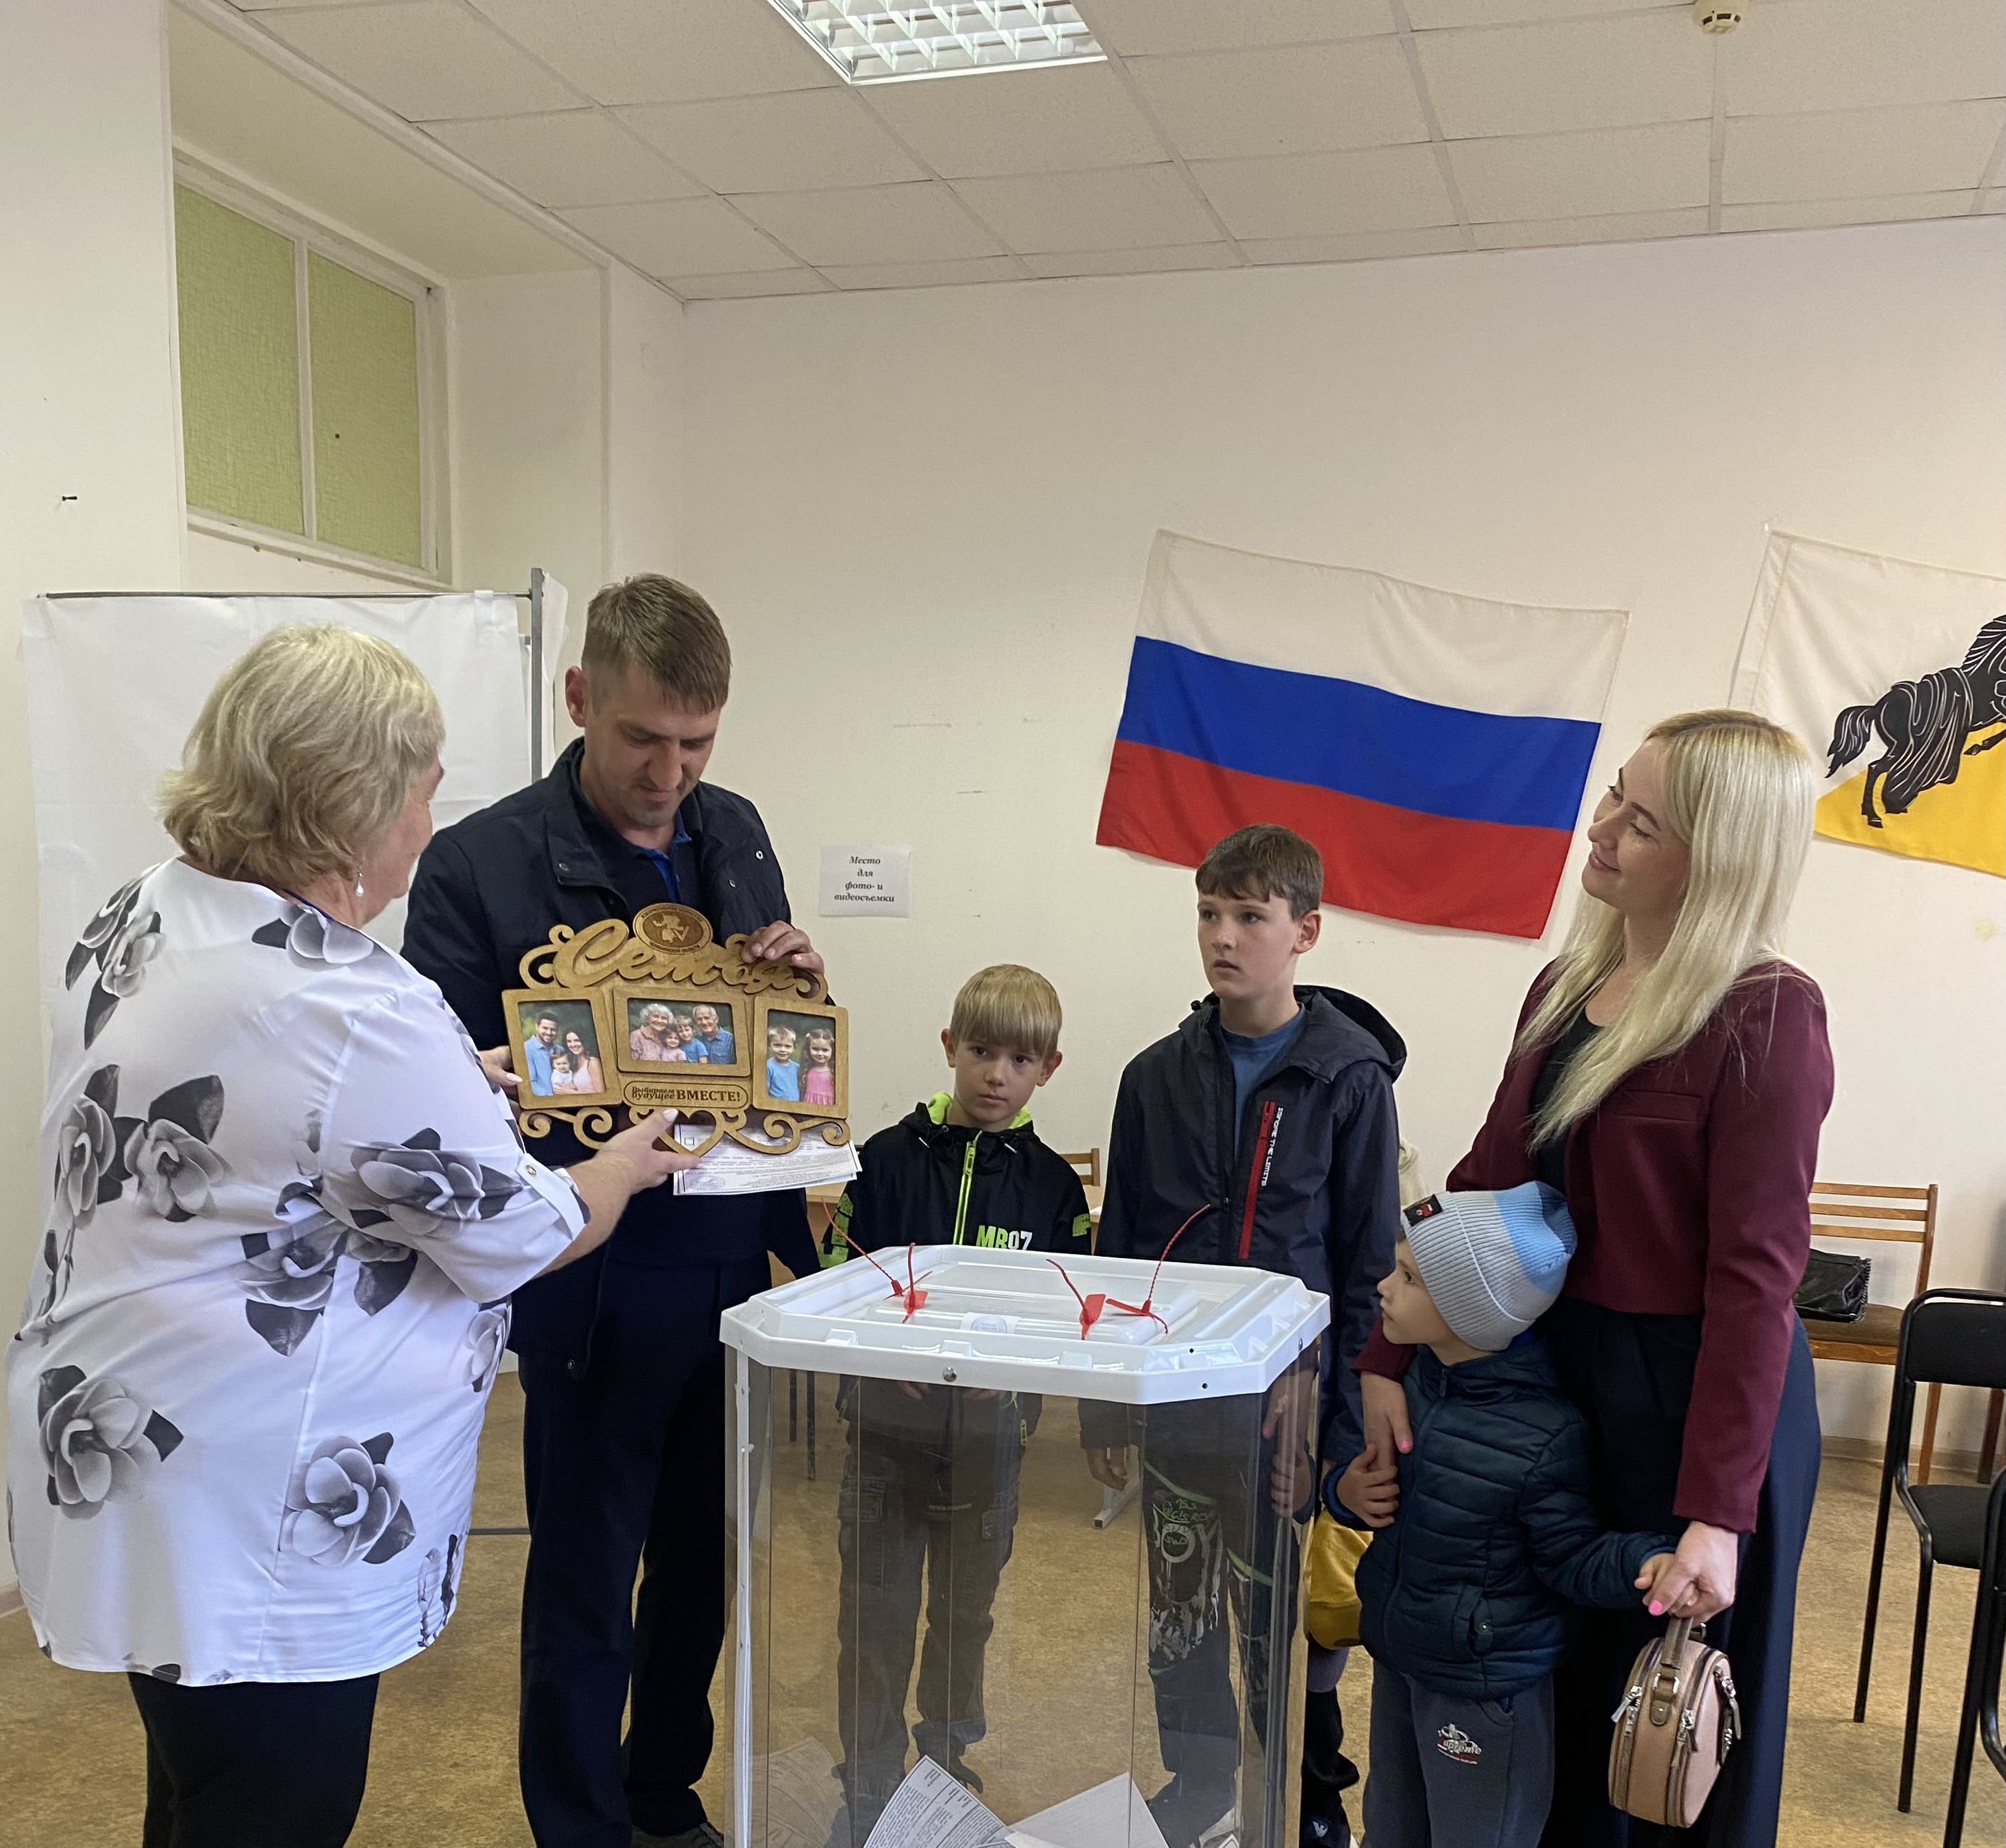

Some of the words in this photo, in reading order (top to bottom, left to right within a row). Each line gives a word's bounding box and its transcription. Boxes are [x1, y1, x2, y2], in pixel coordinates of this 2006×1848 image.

[849, 856, 881, 865] Место
[857, 869, 873, 877] для
[845, 881, 875, 891] фото-
[834, 893, 895, 902] видеосъемки
[676, 1089, 740, 1101] ВМЕСТЕ!
